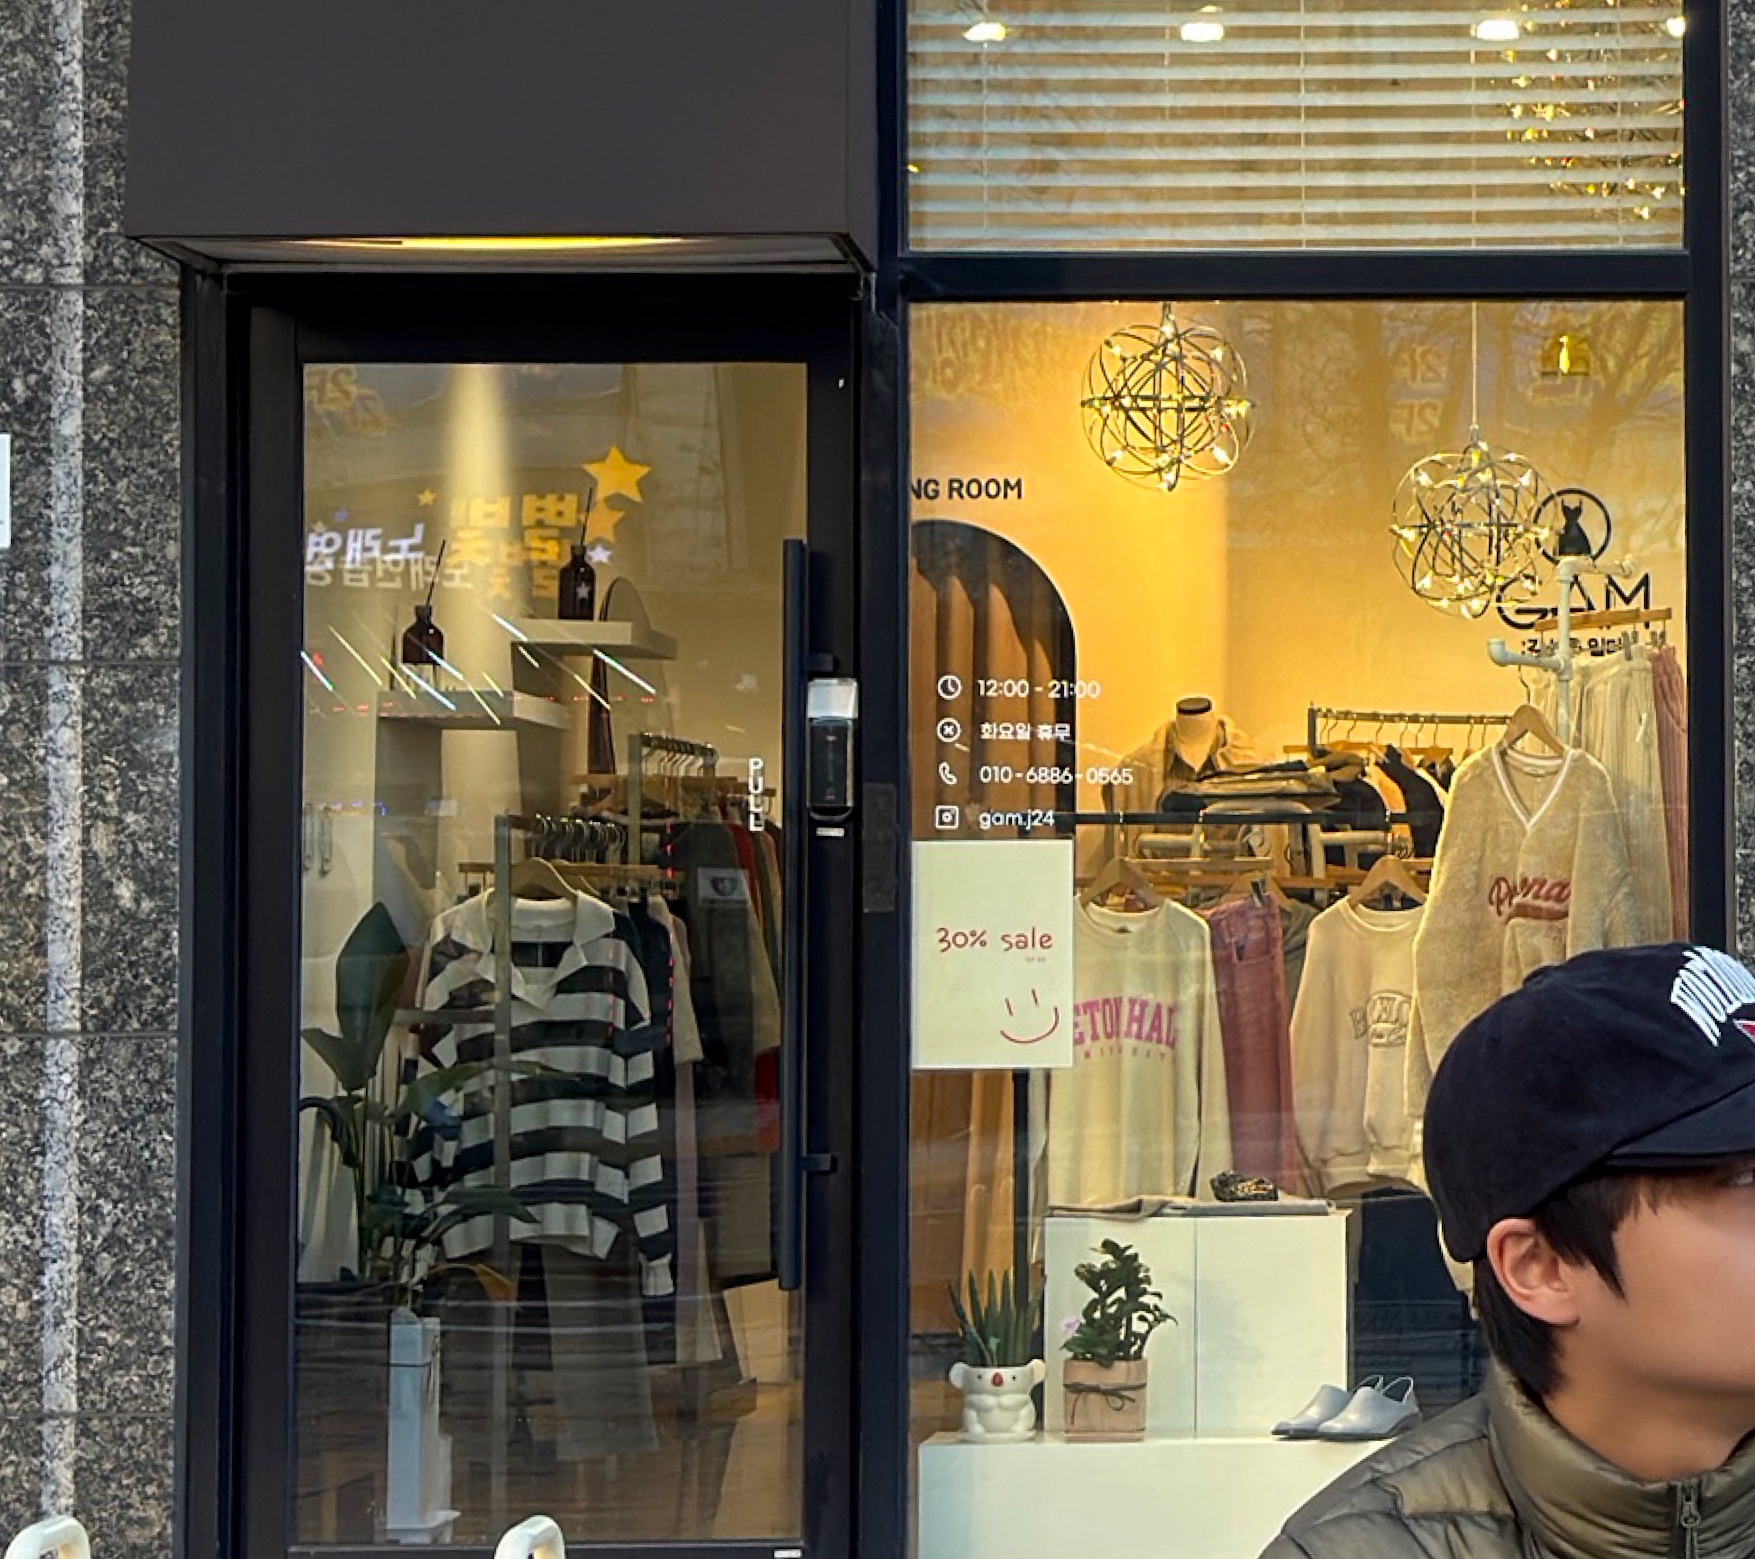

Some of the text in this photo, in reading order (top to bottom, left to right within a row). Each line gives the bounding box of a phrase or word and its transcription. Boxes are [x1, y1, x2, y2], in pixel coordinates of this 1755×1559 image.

[947, 476, 1023, 500] ROOM
[1496, 572, 1650, 630] GAM
[978, 679, 1030, 698] 12:00
[1048, 680, 1101, 699] 21:00
[979, 721, 1072, 743] 화요일 휴무
[748, 757, 765, 832] PULL
[936, 926, 1053, 952] 30% sale
